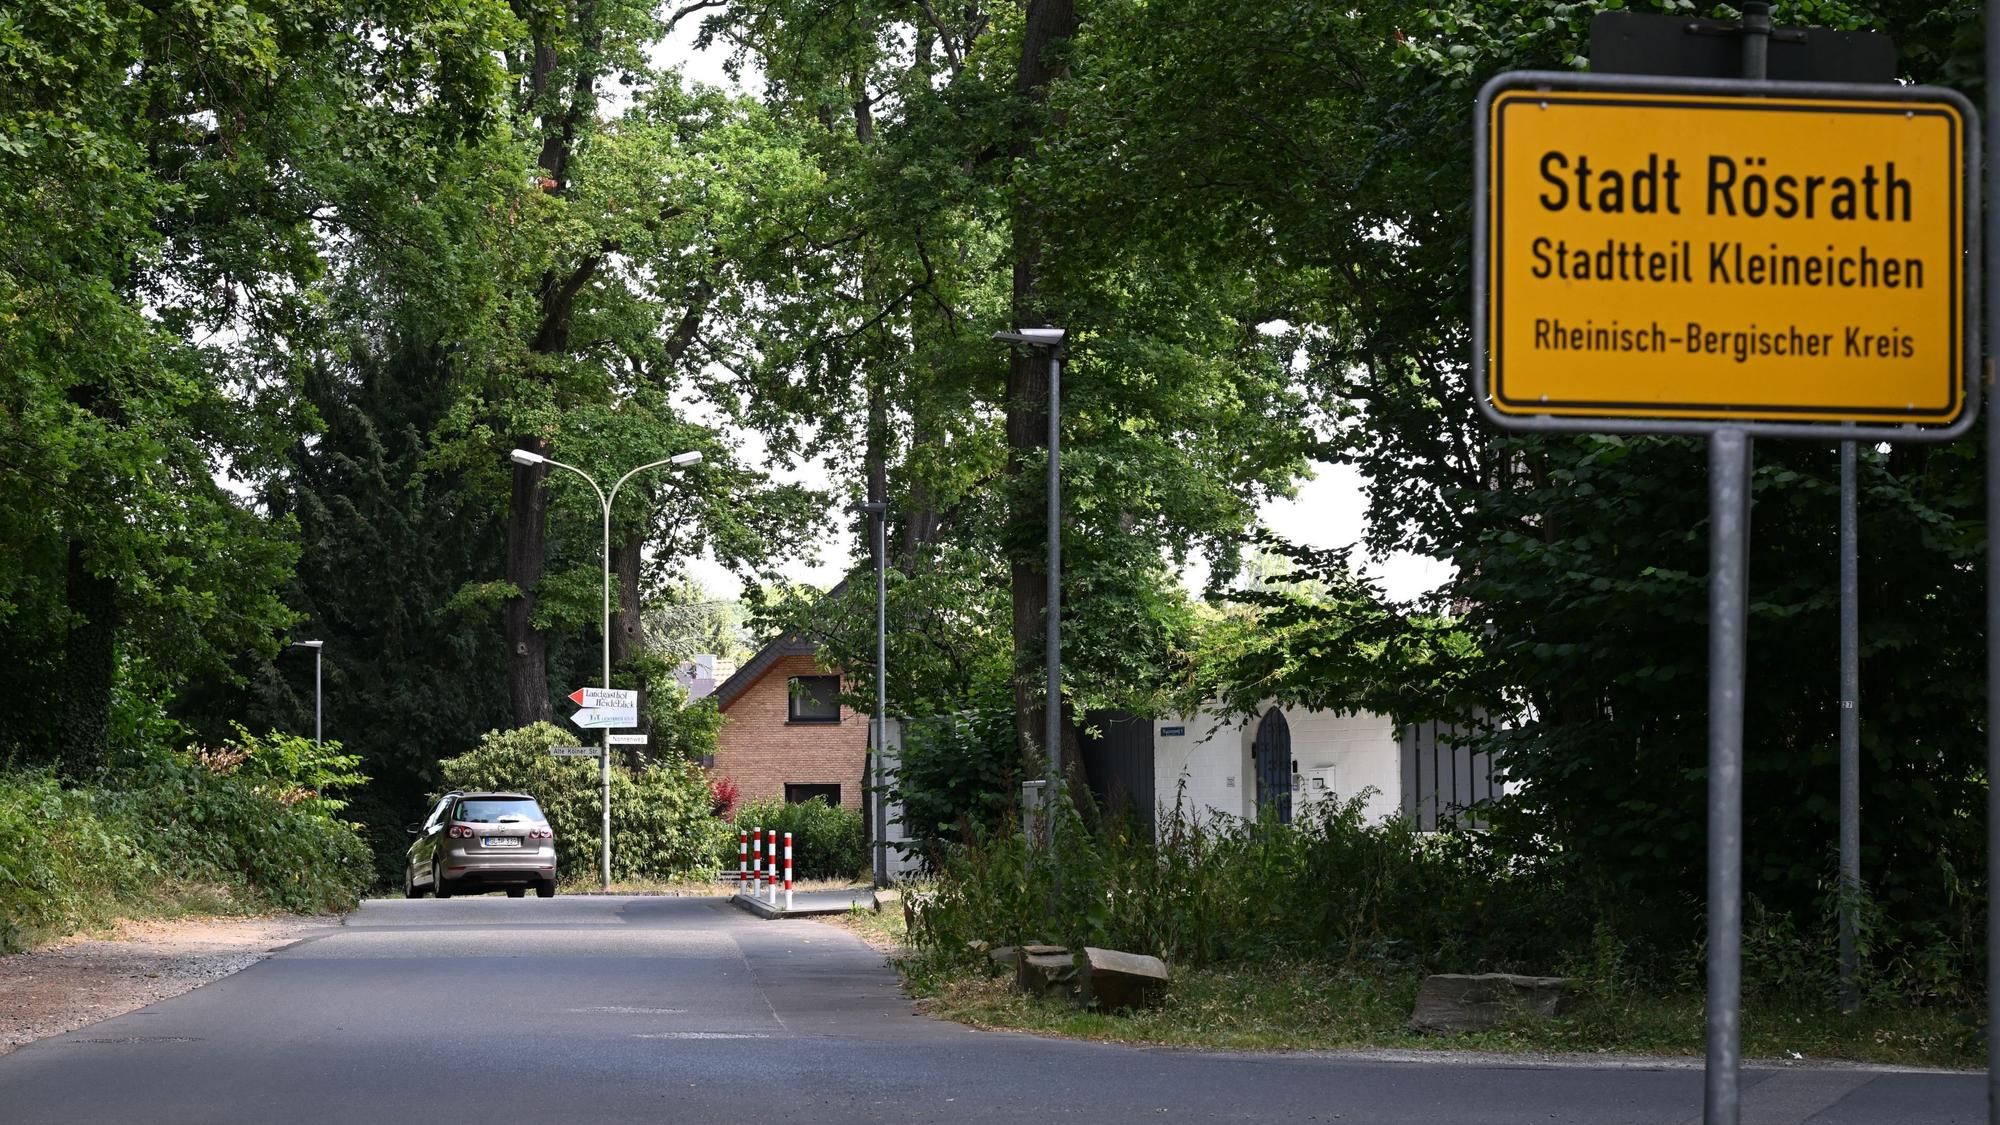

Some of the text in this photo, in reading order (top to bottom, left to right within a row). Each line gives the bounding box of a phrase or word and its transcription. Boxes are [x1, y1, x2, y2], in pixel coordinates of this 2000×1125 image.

[1540, 150, 1913, 222] Stadt Rösrath
[1531, 236, 1924, 289] Stadtteil Kleineichen
[1534, 319, 1915, 363] Rheinisch-Bergischer Kreis
[585, 690, 628, 700] Landgasthof
[595, 698, 634, 709] Heideblick
[588, 747, 599, 755] Str.
